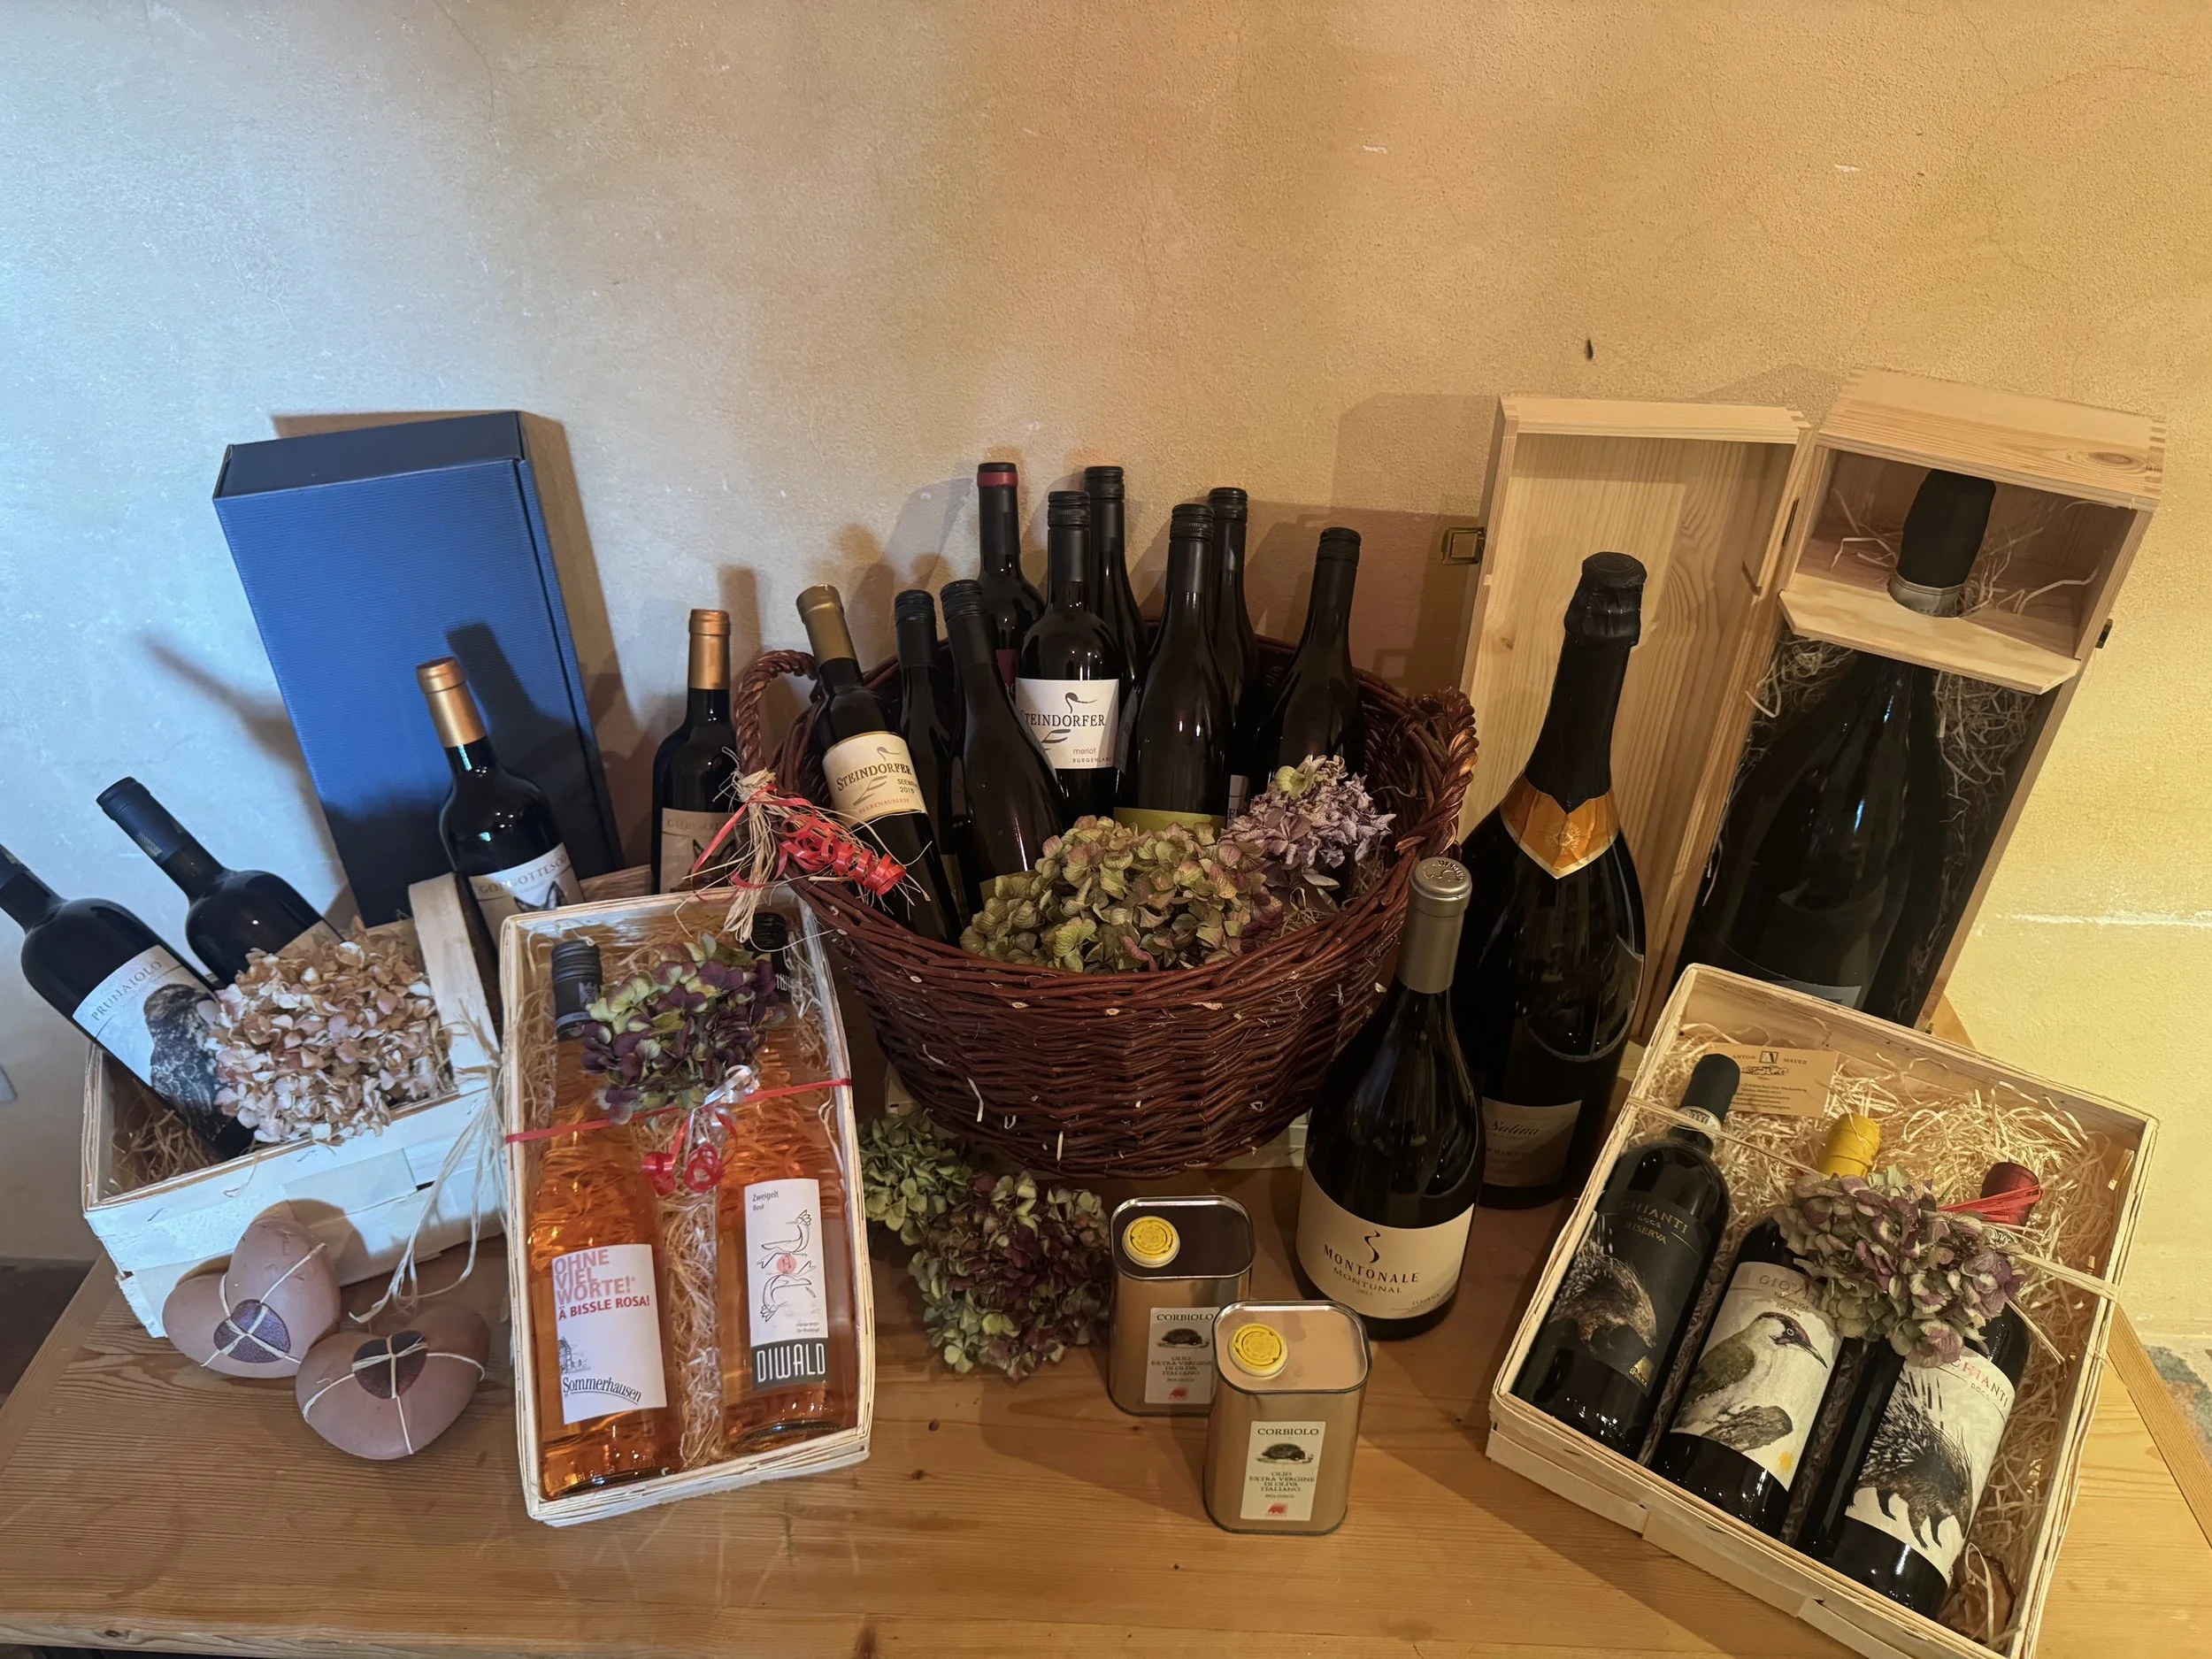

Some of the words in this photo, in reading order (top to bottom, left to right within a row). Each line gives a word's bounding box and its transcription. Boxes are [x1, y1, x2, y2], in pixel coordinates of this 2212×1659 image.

[1072, 747, 1096, 756] merlot
[836, 763, 912, 791] STEINDORFER
[90, 961, 163, 1022] PRUNAIOLO
[752, 1190, 780, 1202] Zweigelt
[1624, 1222, 1667, 1245] RISERVA
[554, 1248, 610, 1275] OHNE
[1324, 1244, 1419, 1284] MONTONALE
[555, 1267, 597, 1290] VIEL
[1333, 1265, 1402, 1294] MONTUNAL
[570, 1299, 612, 1317] BISSLE
[615, 1294, 650, 1310] ROSA!
[756, 1343, 826, 1384] DIWALD
[562, 1377, 642, 1403] Sommerhausen
